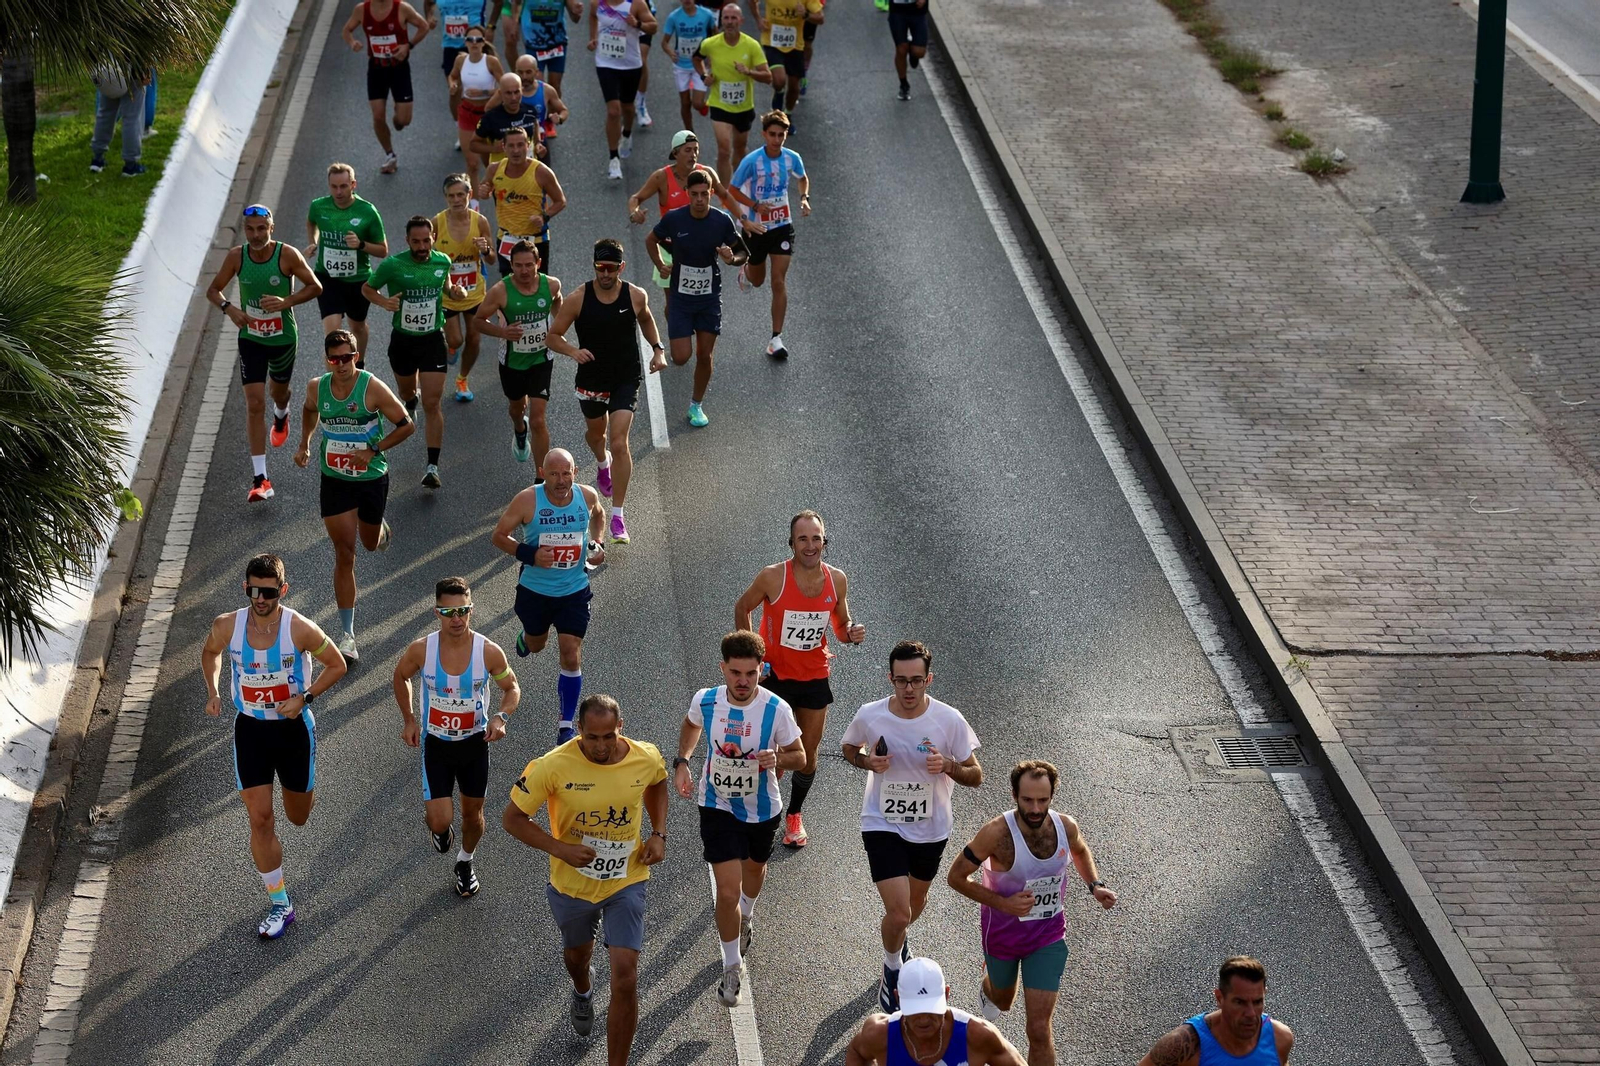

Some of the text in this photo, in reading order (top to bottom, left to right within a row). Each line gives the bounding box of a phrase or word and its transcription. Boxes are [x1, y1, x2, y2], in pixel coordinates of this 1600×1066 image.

[448, 26, 465, 35] 100
[773, 33, 795, 43] 8840
[379, 45, 391, 54] 75
[601, 42, 625, 54] 11148
[722, 90, 745, 100] 8126
[326, 260, 355, 271] 6458
[456, 276, 470, 287] 41
[682, 278, 710, 290] 2232
[405, 313, 433, 325] 6457
[515, 309, 547, 322] mijas
[254, 321, 276, 333] 144
[516, 332, 547, 345] 1863
[539, 513, 576, 526] nerja
[786, 627, 824, 641] 7425
[254, 690, 275, 703] 21
[440, 715, 462, 730] 30
[713, 772, 753, 789] 6441
[884, 798, 927, 815] 2541
[575, 810, 601, 827] 45
